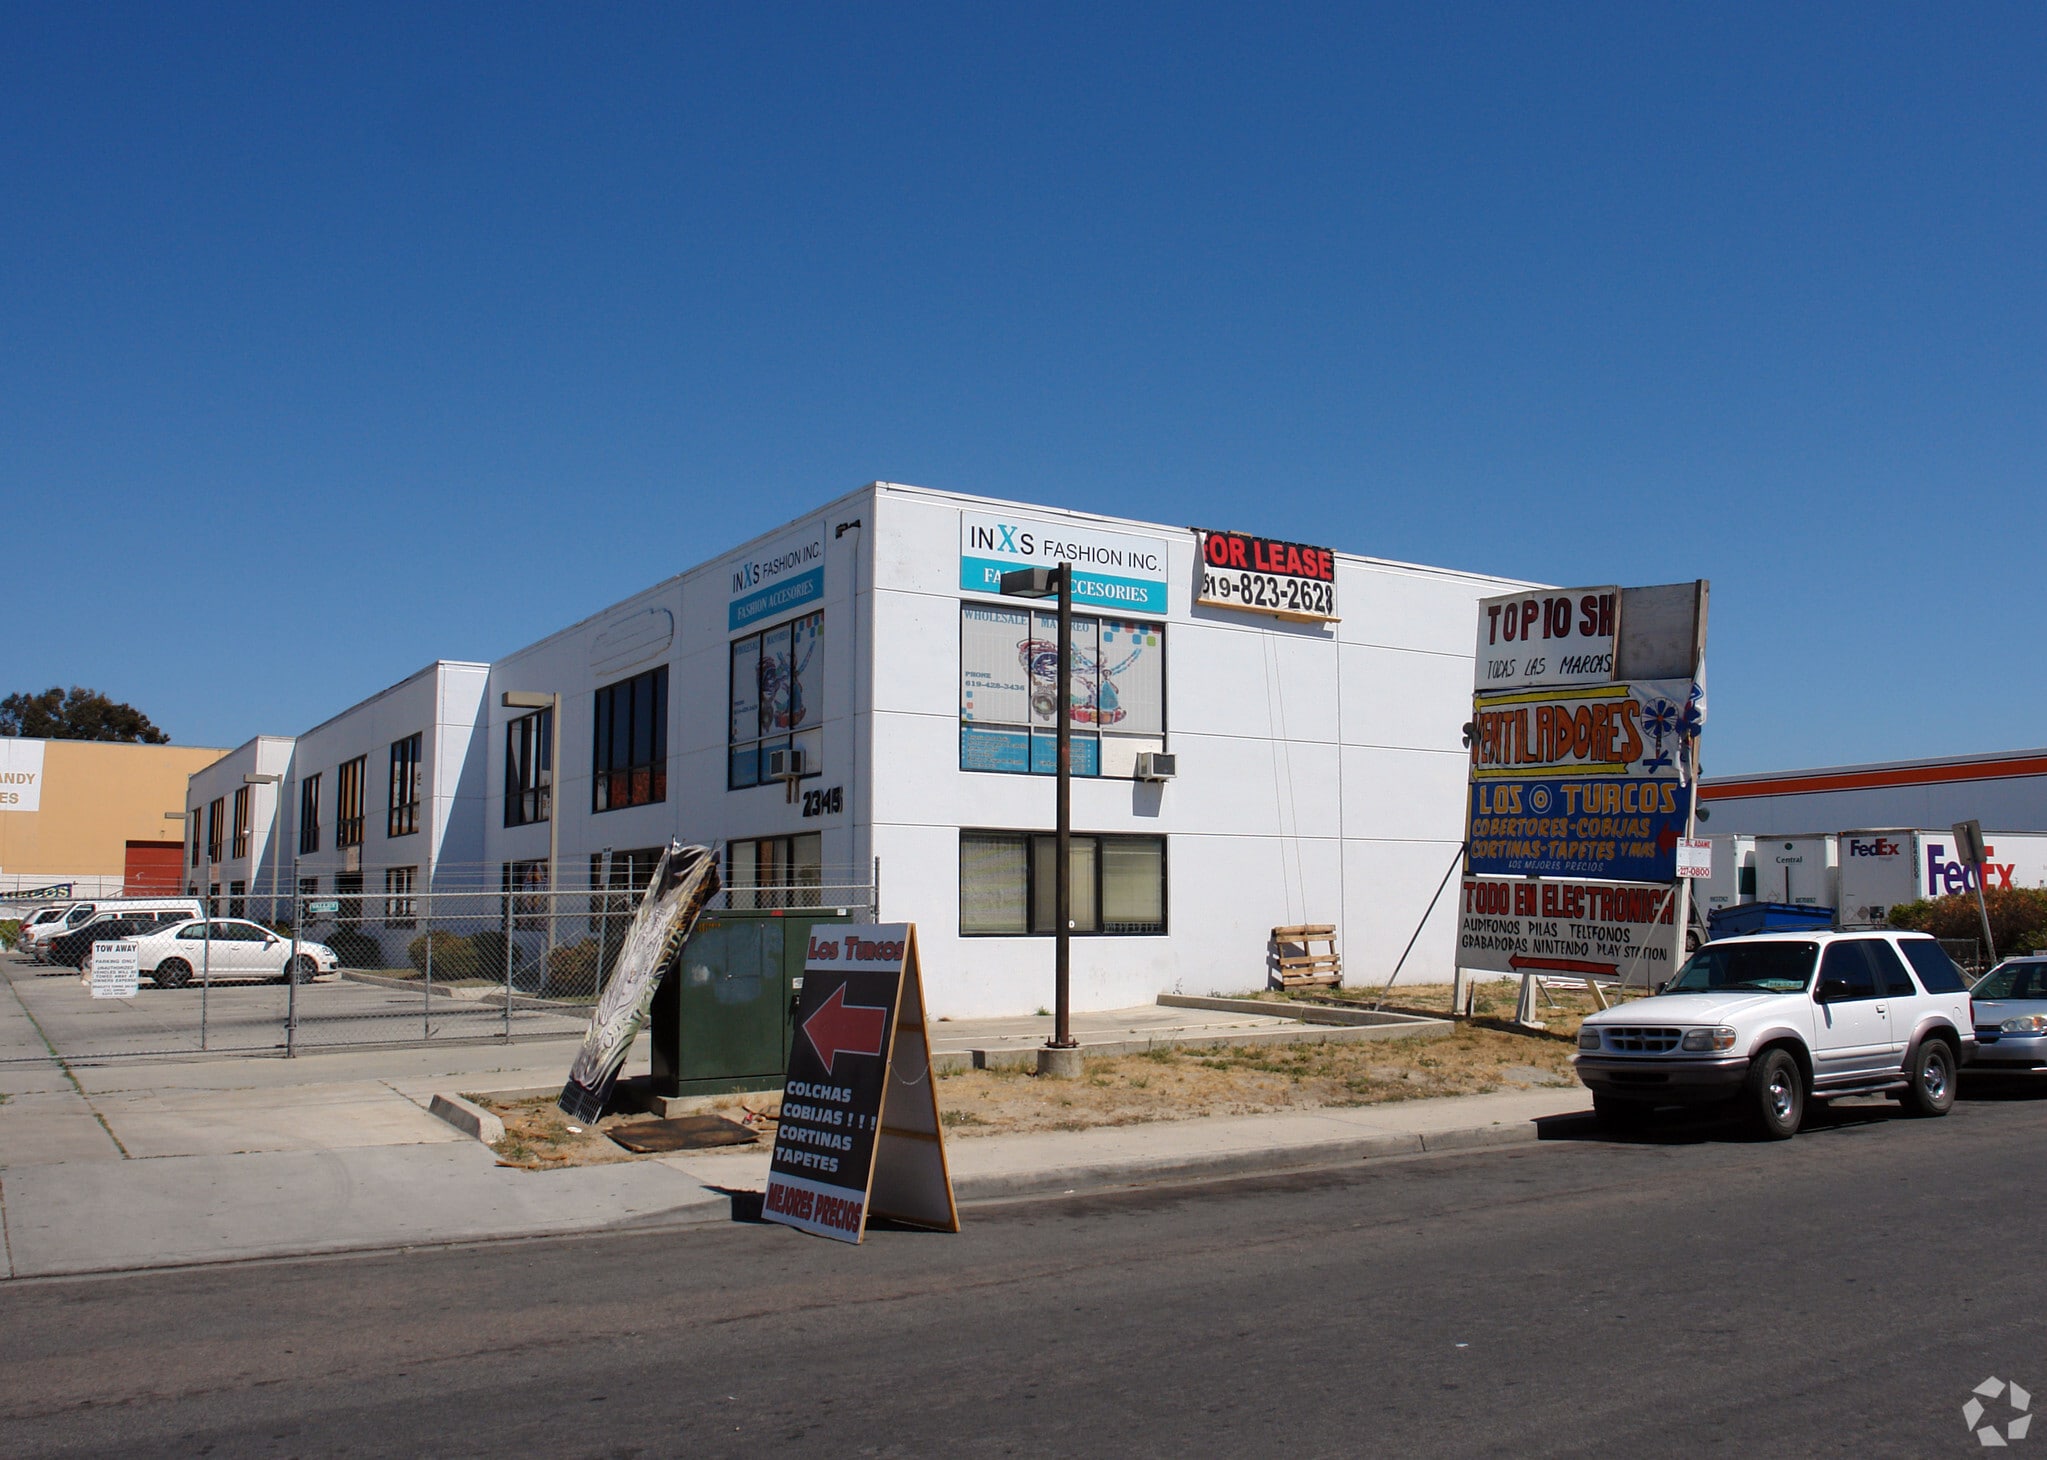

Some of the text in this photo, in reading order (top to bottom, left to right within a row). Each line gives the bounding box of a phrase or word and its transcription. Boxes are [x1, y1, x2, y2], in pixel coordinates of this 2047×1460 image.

[971, 524, 1162, 572] INXS FASHION INC.
[1253, 541, 1333, 580] LEASE
[733, 541, 822, 593] INXS FASHION INC.
[737, 579, 814, 620] FASHION ACCESORIES
[1069, 579, 1149, 602] CCESORIES
[964, 609, 1027, 626] WHOLESALE
[1041, 617, 1089, 632] MAREO
[965, 671, 991, 679] PHONE
[1487, 653, 1612, 680] TODAS LAS MARCAS
[1472, 699, 1643, 765] VENTILADORES
[802, 786, 844, 818] 2345
[1479, 781, 1677, 816] LOS TURCOS
[1775, 856, 1803, 864] Central
[1850, 838, 1900, 857] FedEx
[1508, 860, 1604, 872] LOS MEJORES PRECIOS
[1463, 881, 1675, 924] TODO EN ELECTRONICA
[1528, 921, 1558, 937] PILAS
[1569, 924, 1630, 943] TELEFONOS
[808, 936, 839, 960] LOS
[1533, 939, 1589, 956] NINTENDO
[1596, 942, 1620, 957] PLAY
[787, 1081, 852, 1103] COLCHAS
[783, 1103, 843, 1126] COBIJAS
[779, 1124, 853, 1151] CORTINAS
[775, 1147, 839, 1173] TAPETES
[766, 1182, 862, 1233] MEJORES PRECIOS
